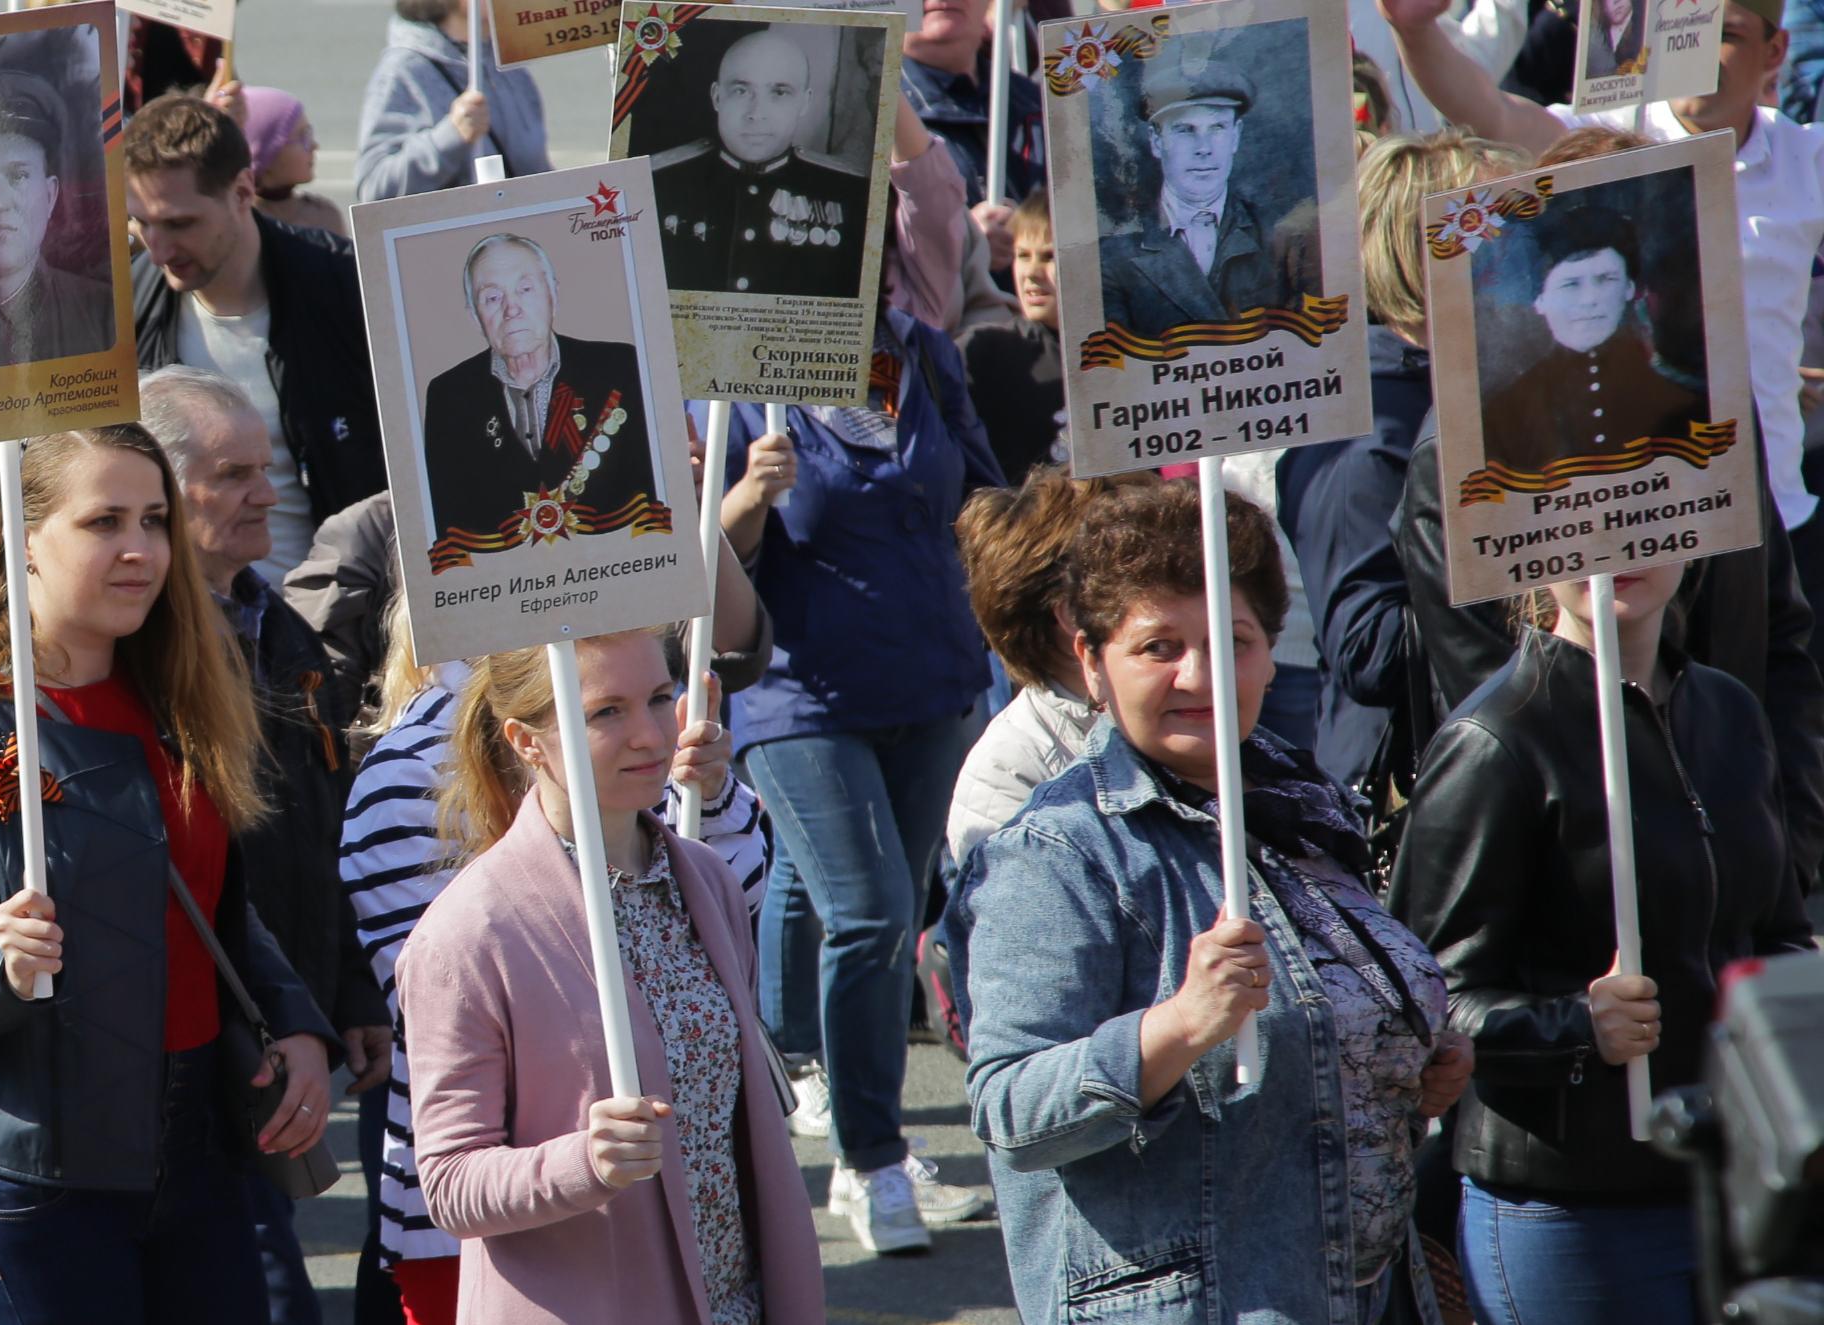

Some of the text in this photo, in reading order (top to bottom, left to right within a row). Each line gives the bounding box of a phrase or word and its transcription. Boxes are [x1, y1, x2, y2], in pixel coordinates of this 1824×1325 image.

[516, 7, 568, 26] Иван
[591, 227, 626, 241] ПОЛК
[752, 345, 859, 365] Скорняков
[1153, 347, 1283, 384] Рядовой
[50, 368, 117, 389] Коробкин
[759, 363, 858, 382] Евлампий
[34, 383, 118, 406] Артемович
[706, 378, 856, 400] Александрович
[1093, 368, 1342, 431] Гарин Николай
[48, 400, 119, 417] красноармеец
[1128, 429, 1202, 458] 1902
[1238, 413, 1309, 442] 1941
[1533, 472, 1670, 514] Рядовой
[1474, 489, 1732, 557] Туриков Николай
[1508, 552, 1584, 582] 1903
[1621, 530, 1698, 560] 1946
[434, 553, 677, 608] Венгер Илья Алексеевич
[521, 590, 598, 614] Ефрейтор
